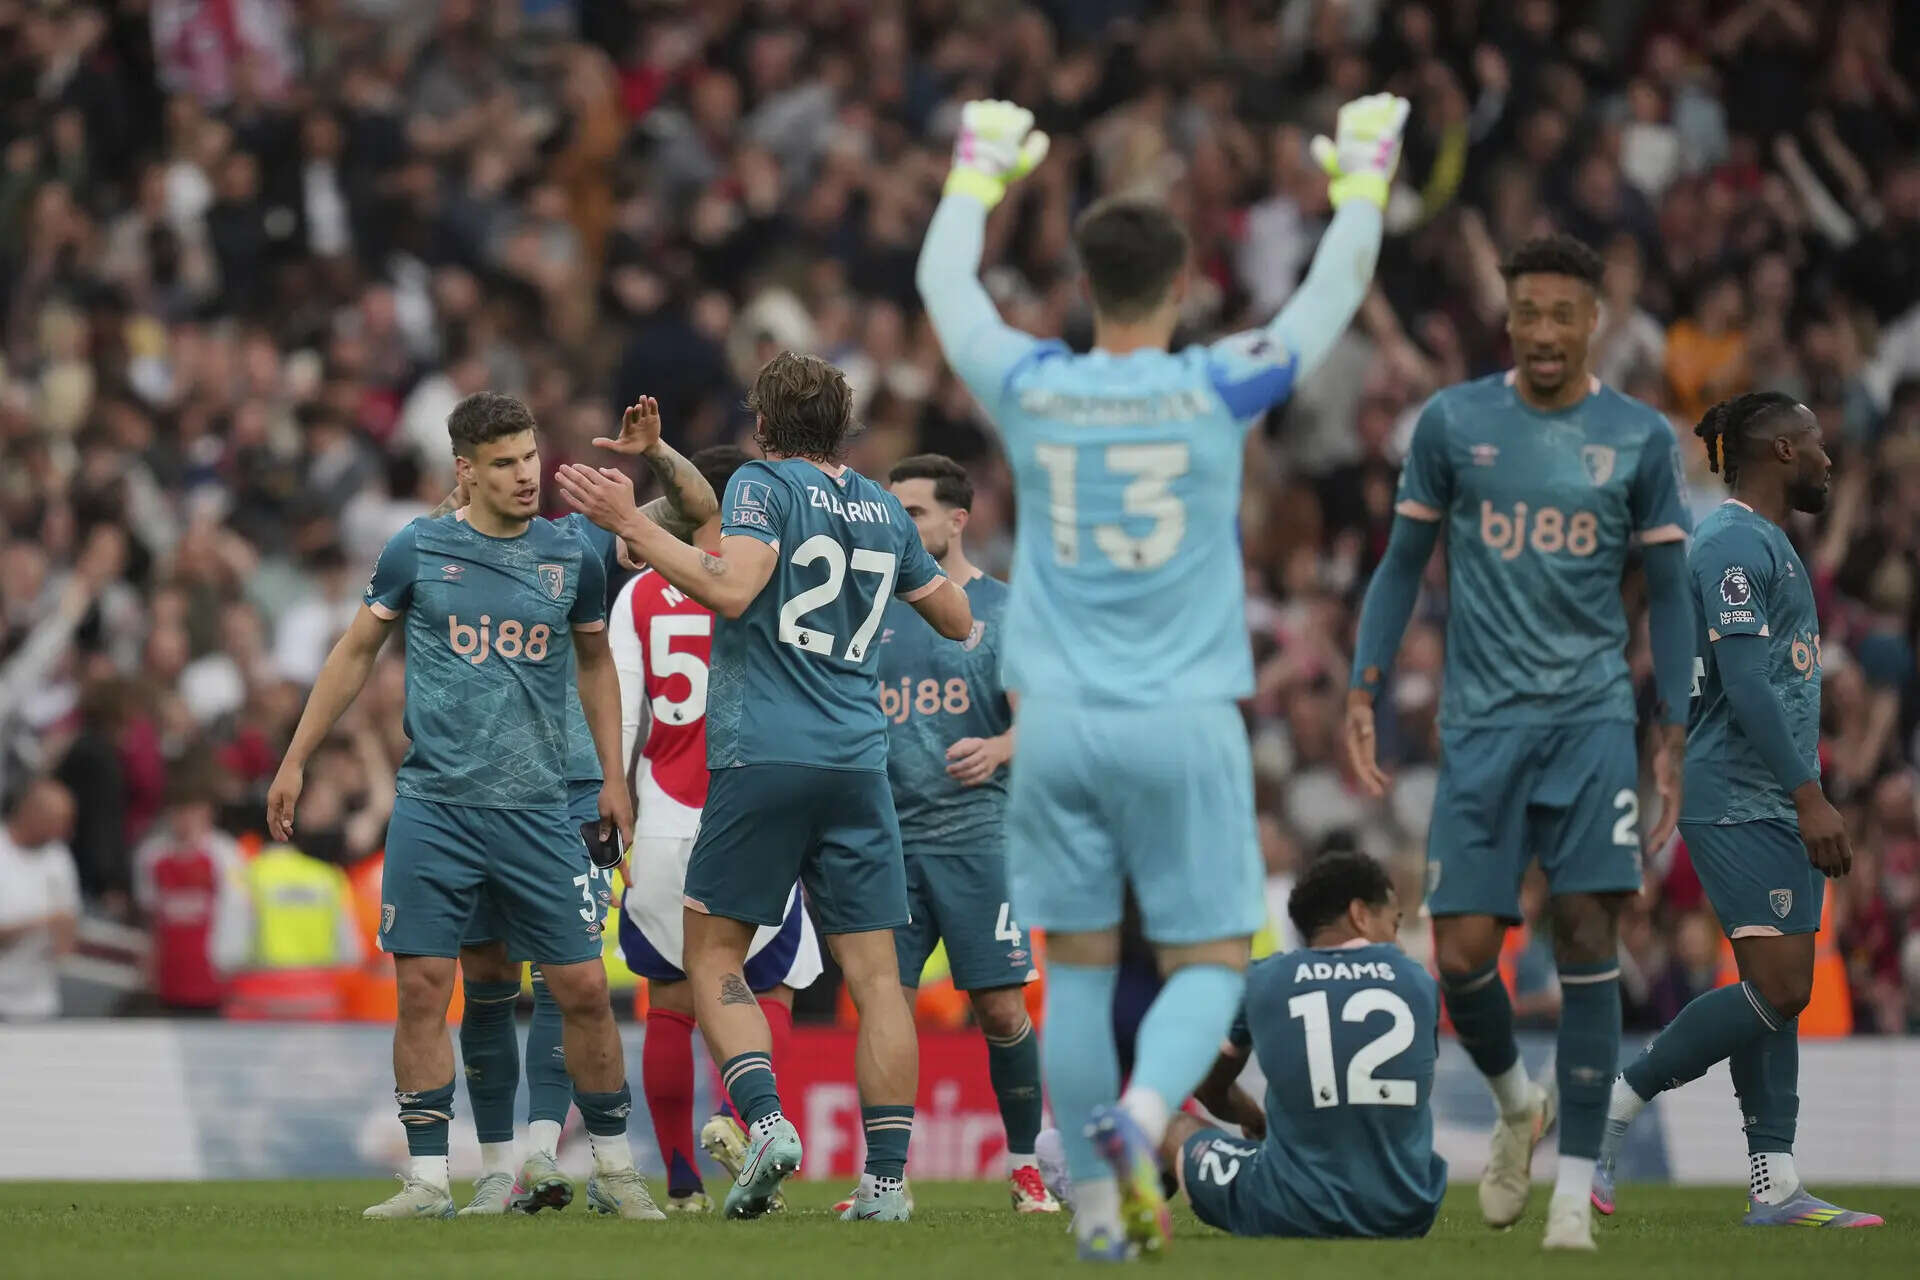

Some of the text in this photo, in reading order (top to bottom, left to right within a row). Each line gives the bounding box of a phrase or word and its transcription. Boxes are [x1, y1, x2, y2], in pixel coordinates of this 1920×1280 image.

[732, 510, 768, 526] LEOS
[807, 485, 890, 524] ZARNYI
[1034, 442, 1190, 571] 13
[1480, 499, 1598, 560] bj88
[778, 534, 896, 663] 27
[448, 614, 550, 664] bj88
[649, 613, 711, 727] 5
[879, 677, 971, 723] bj88
[1613, 788, 1639, 846] 2
[573, 873, 597, 922] 3
[994, 902, 1022, 947] 4
[1294, 961, 1396, 984] ADAMS
[1287, 987, 1417, 1109] 12
